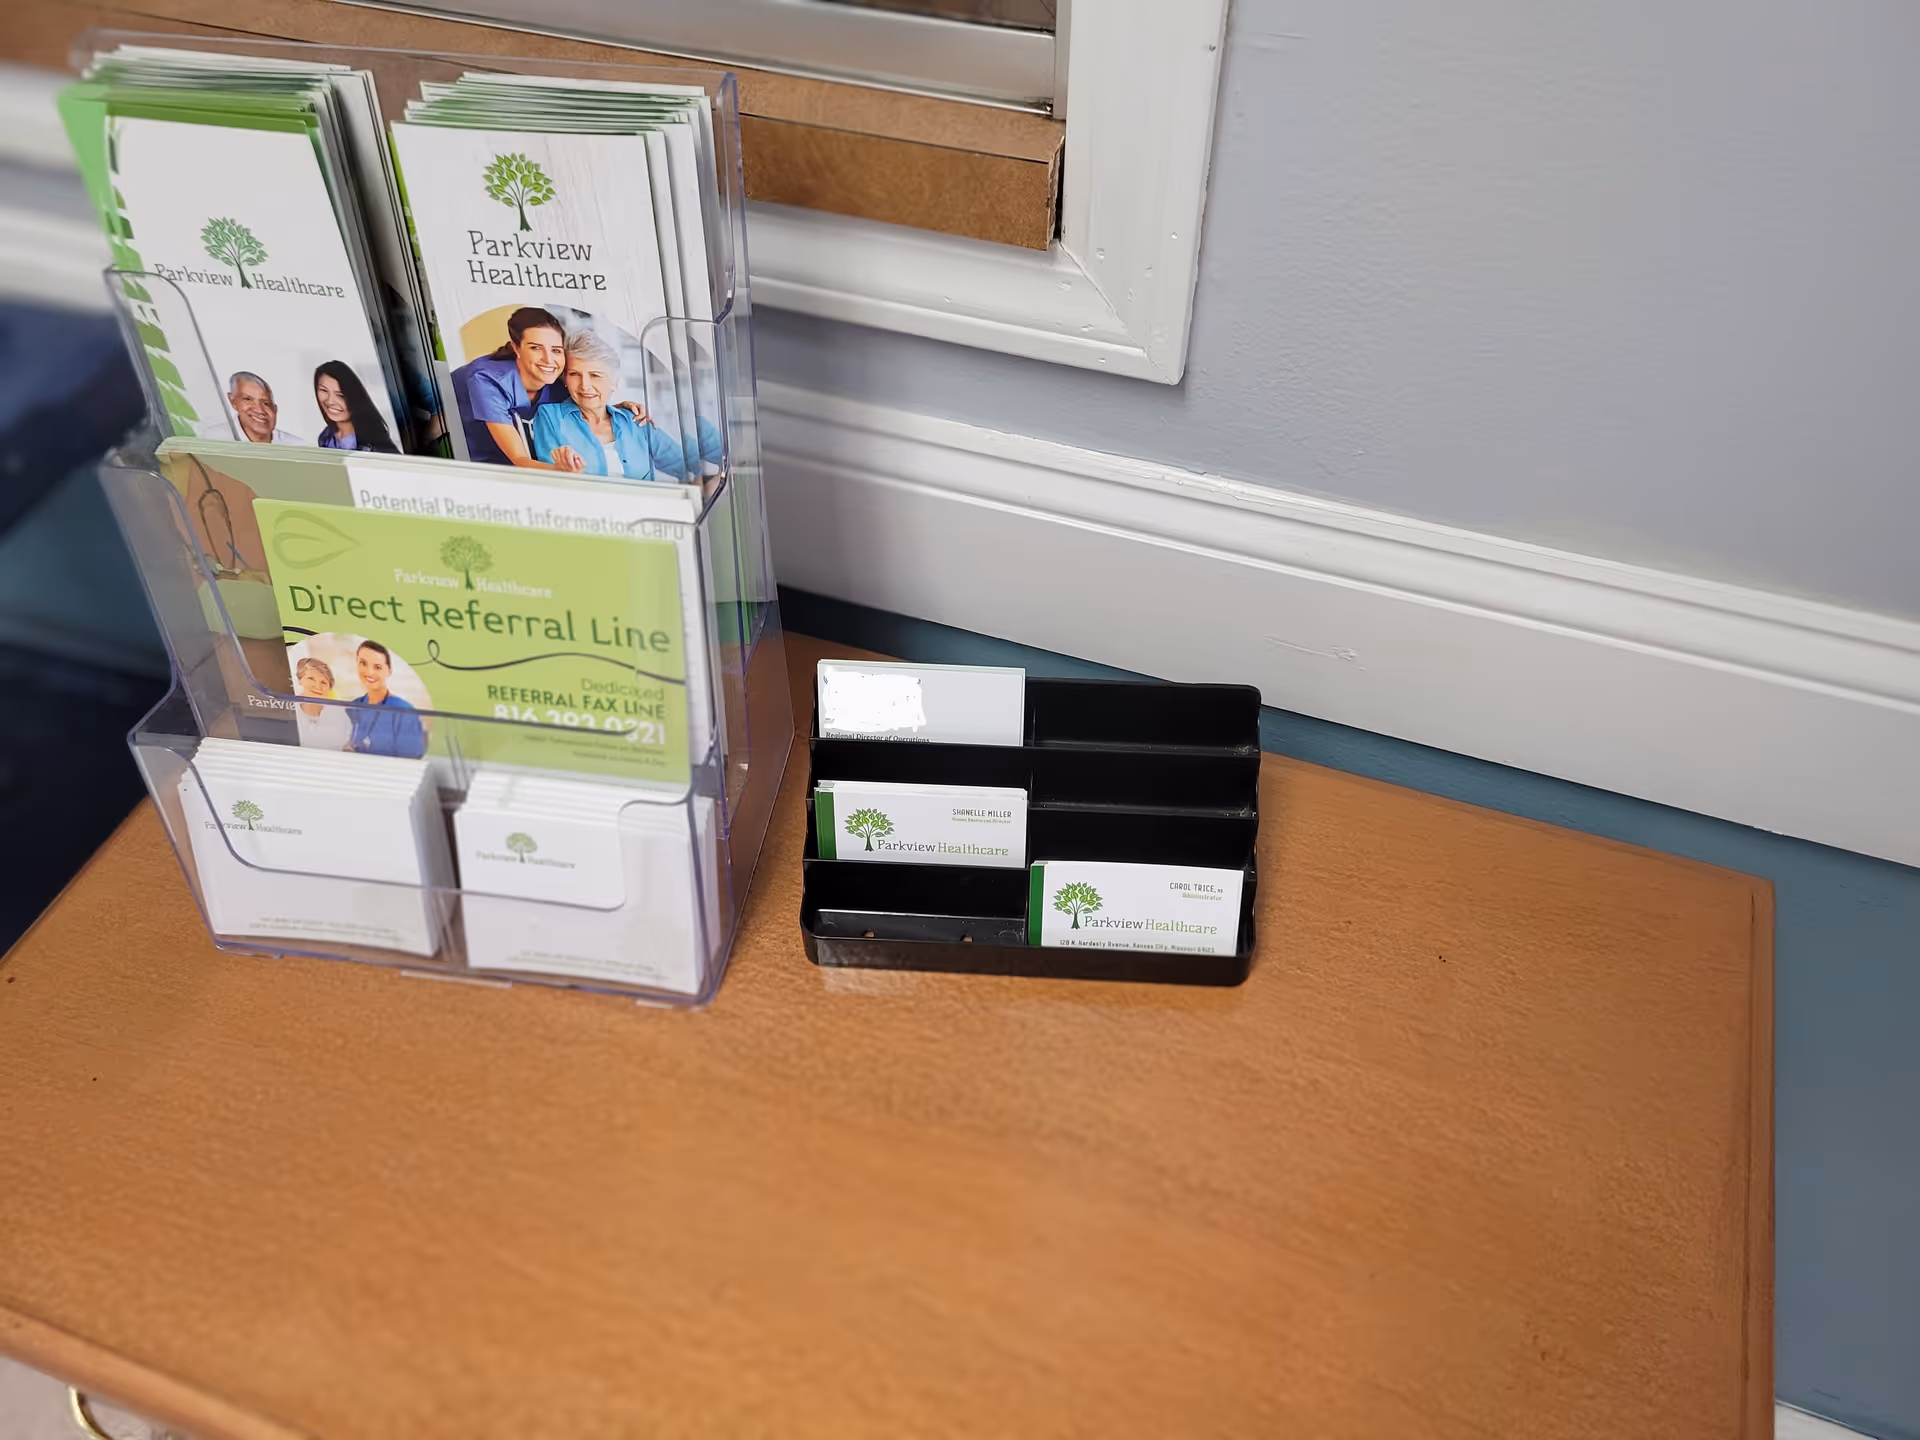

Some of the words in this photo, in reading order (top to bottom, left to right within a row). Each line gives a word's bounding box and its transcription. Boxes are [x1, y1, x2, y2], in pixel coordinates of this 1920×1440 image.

[467, 230, 593, 261] Parkview
[154, 263, 234, 287] Parkview
[251, 272, 346, 299] Healthcare
[466, 259, 608, 291] Healthcare
[359, 488, 441, 516] Potential
[443, 496, 523, 525] Resident
[393, 567, 460, 589] Parkview
[475, 576, 553, 599] Healthcare
[288, 583, 407, 624] Direct
[418, 598, 577, 642] Referral
[591, 616, 672, 654] Line
[487, 684, 578, 709] REFERRAL
[583, 694, 619, 714] FAX
[624, 699, 667, 720] LINE
[580, 677, 666, 702] Dedicated
[952, 808, 986, 818] SHANELLE
[987, 810, 1013, 818] MILLER
[877, 840, 937, 853] Parkview
[937, 842, 1009, 857] Healthcare
[1169, 882, 1192, 892] CAROL
[1084, 915, 1144, 930] Parkview
[1145, 918, 1218, 936] Healthcare
[1078, 940, 1106, 949] Hardesty
